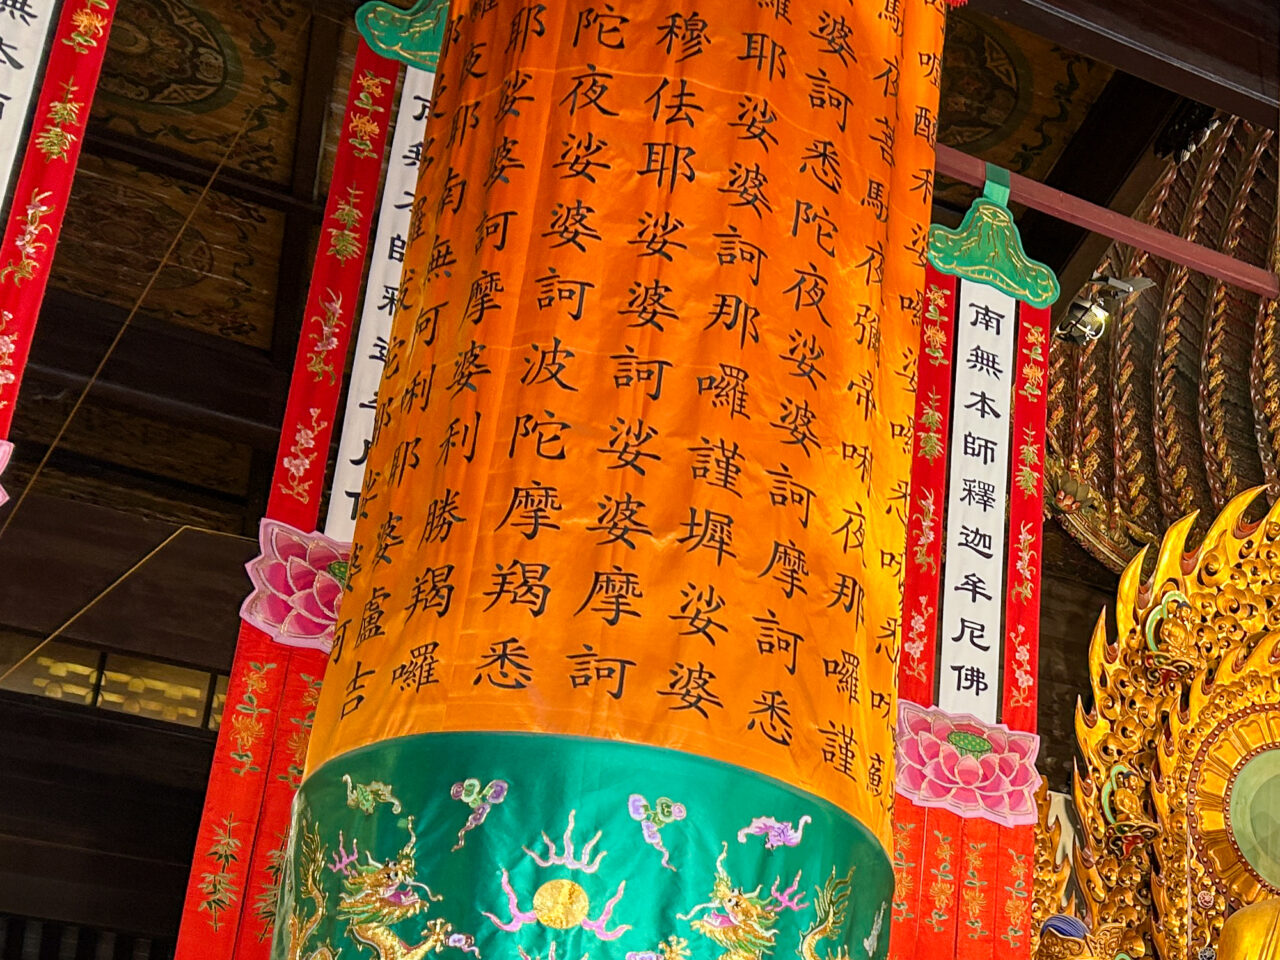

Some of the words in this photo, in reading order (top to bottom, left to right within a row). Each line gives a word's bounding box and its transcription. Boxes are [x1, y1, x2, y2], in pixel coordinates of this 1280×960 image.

[747, 0, 857, 746] 婆訶悉陀夜娑婆訶摩訶悉
[951, 303, 1006, 697] 南無本師釋迦牟尼佛
